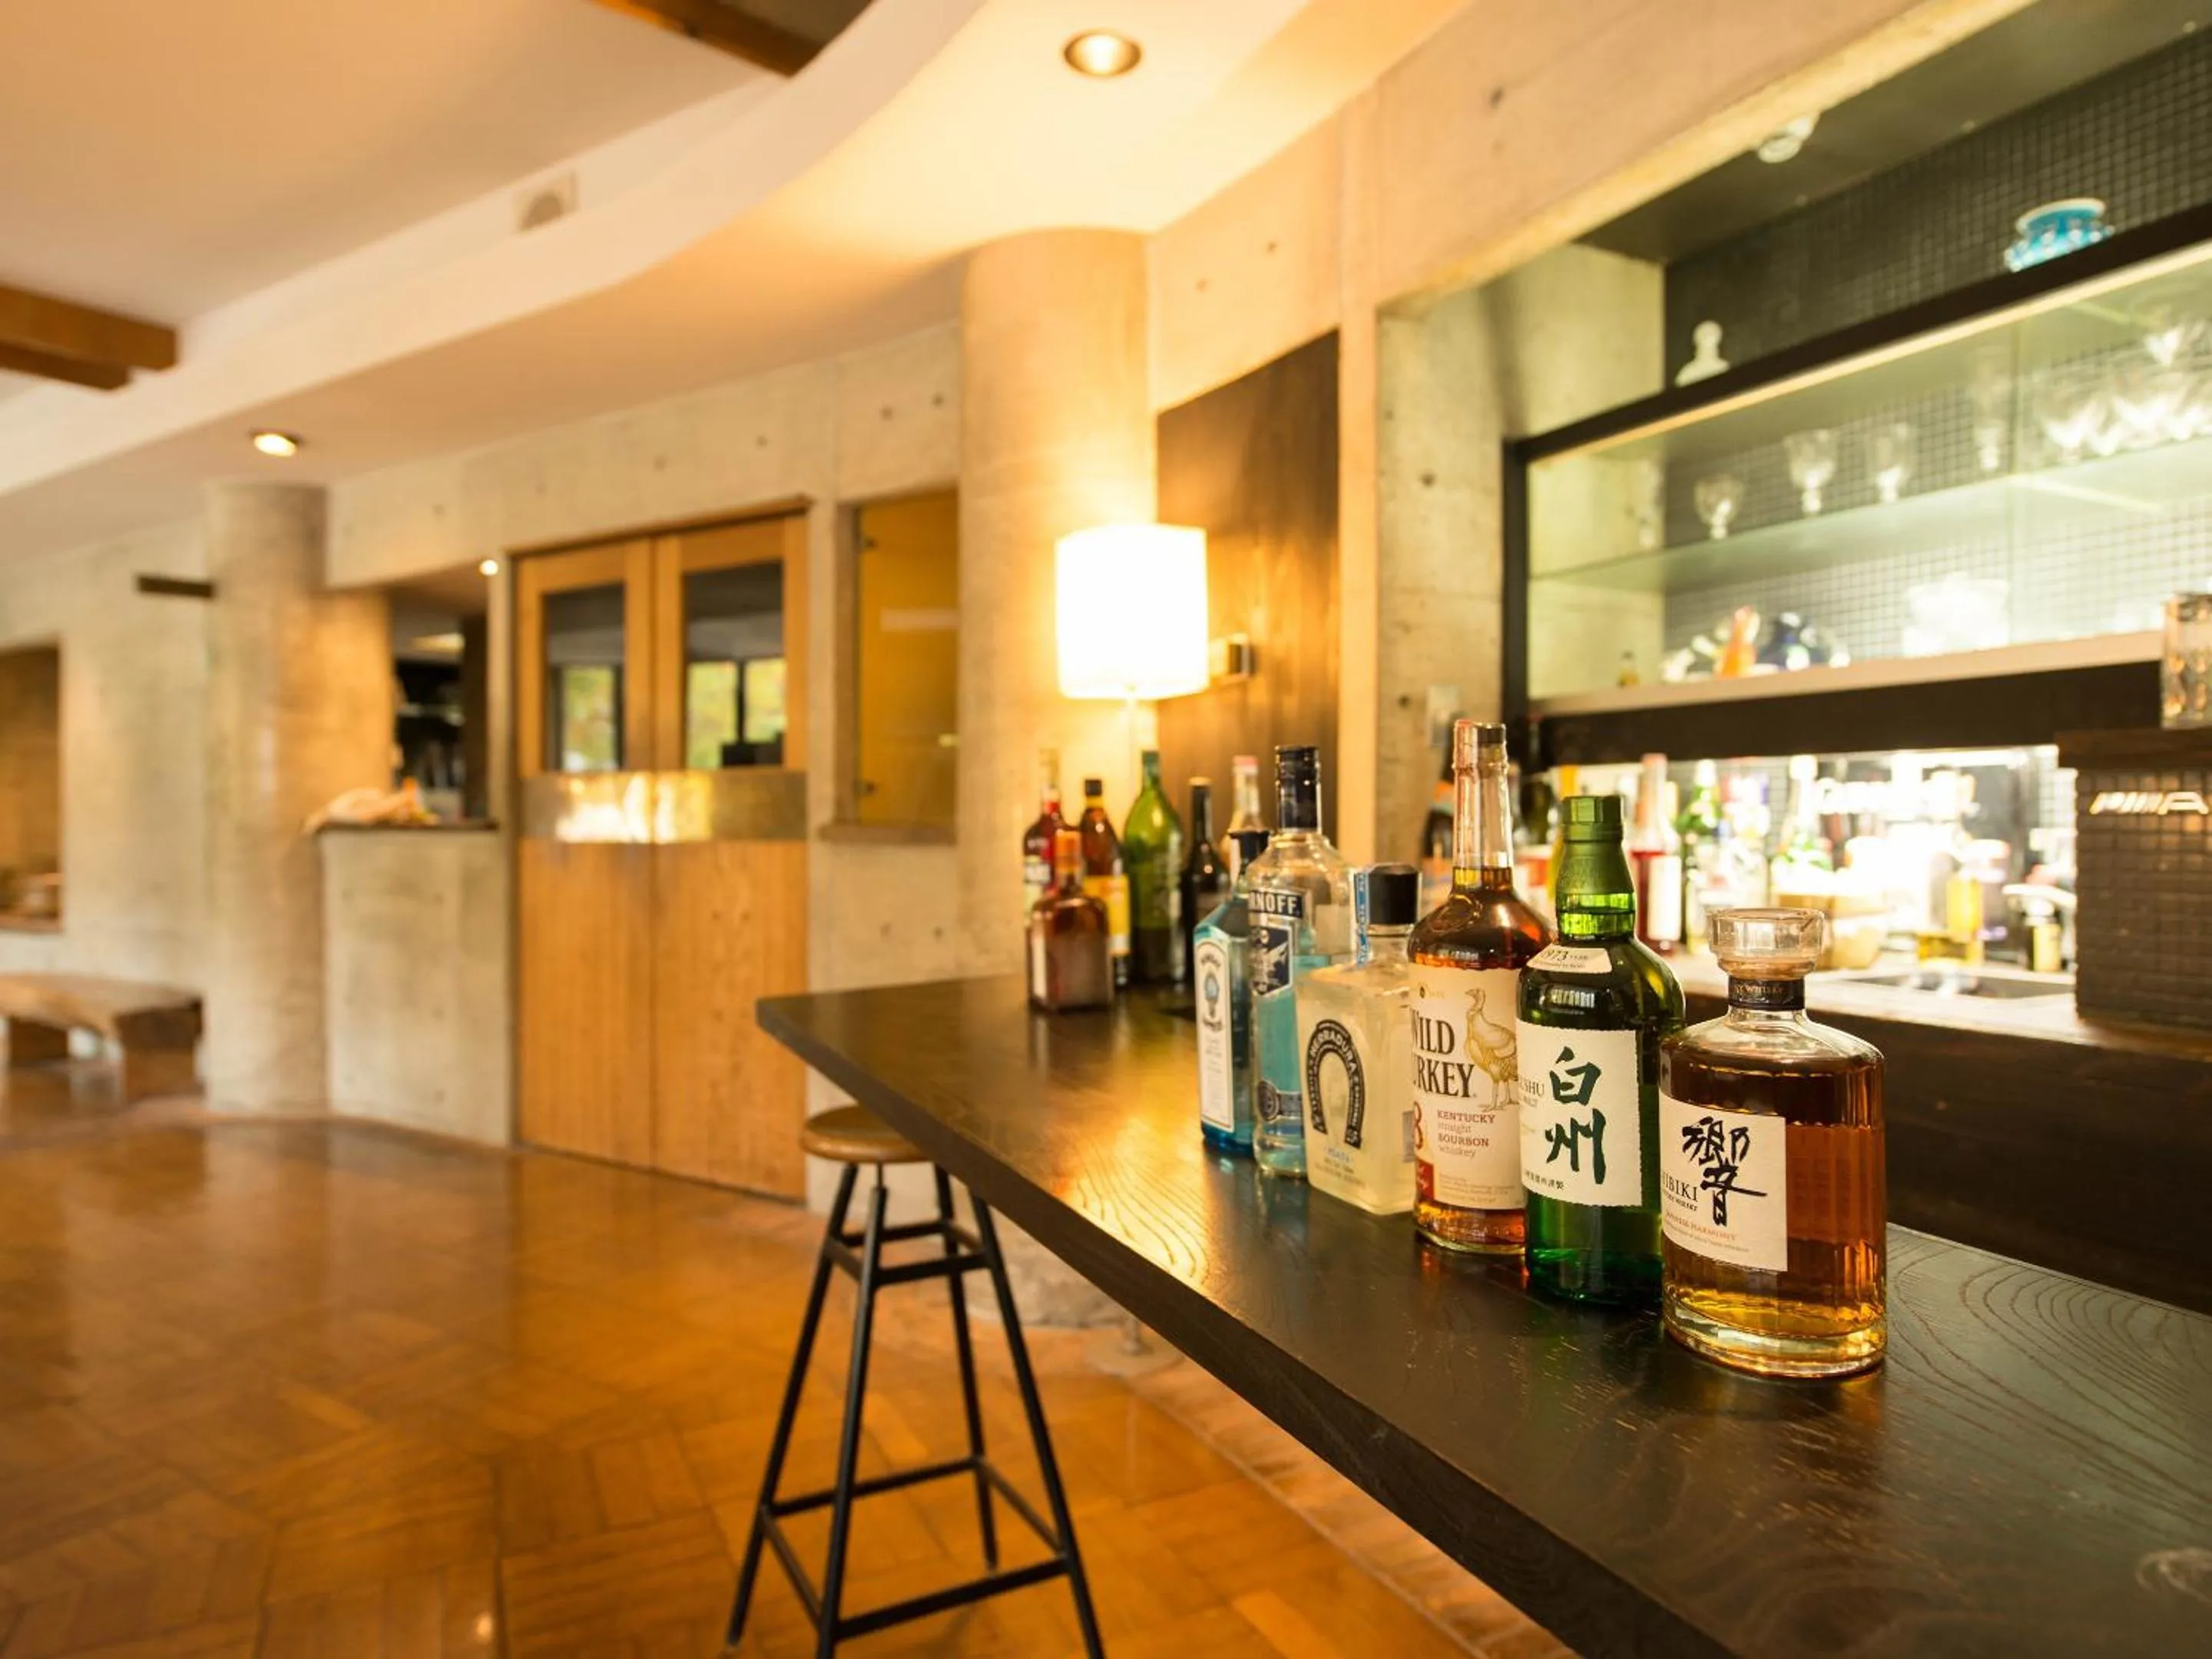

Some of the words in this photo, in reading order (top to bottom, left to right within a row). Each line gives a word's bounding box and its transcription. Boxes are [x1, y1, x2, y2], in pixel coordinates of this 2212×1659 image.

[1410, 1008, 1455, 1055] WILD
[1412, 1055, 1475, 1098] RKEY
[1437, 1109, 1495, 1124] KENTUCKY
[1545, 1045, 1607, 1184] 白州
[1438, 1133, 1489, 1147] BOURBON
[1681, 1116, 1768, 1227] 響
